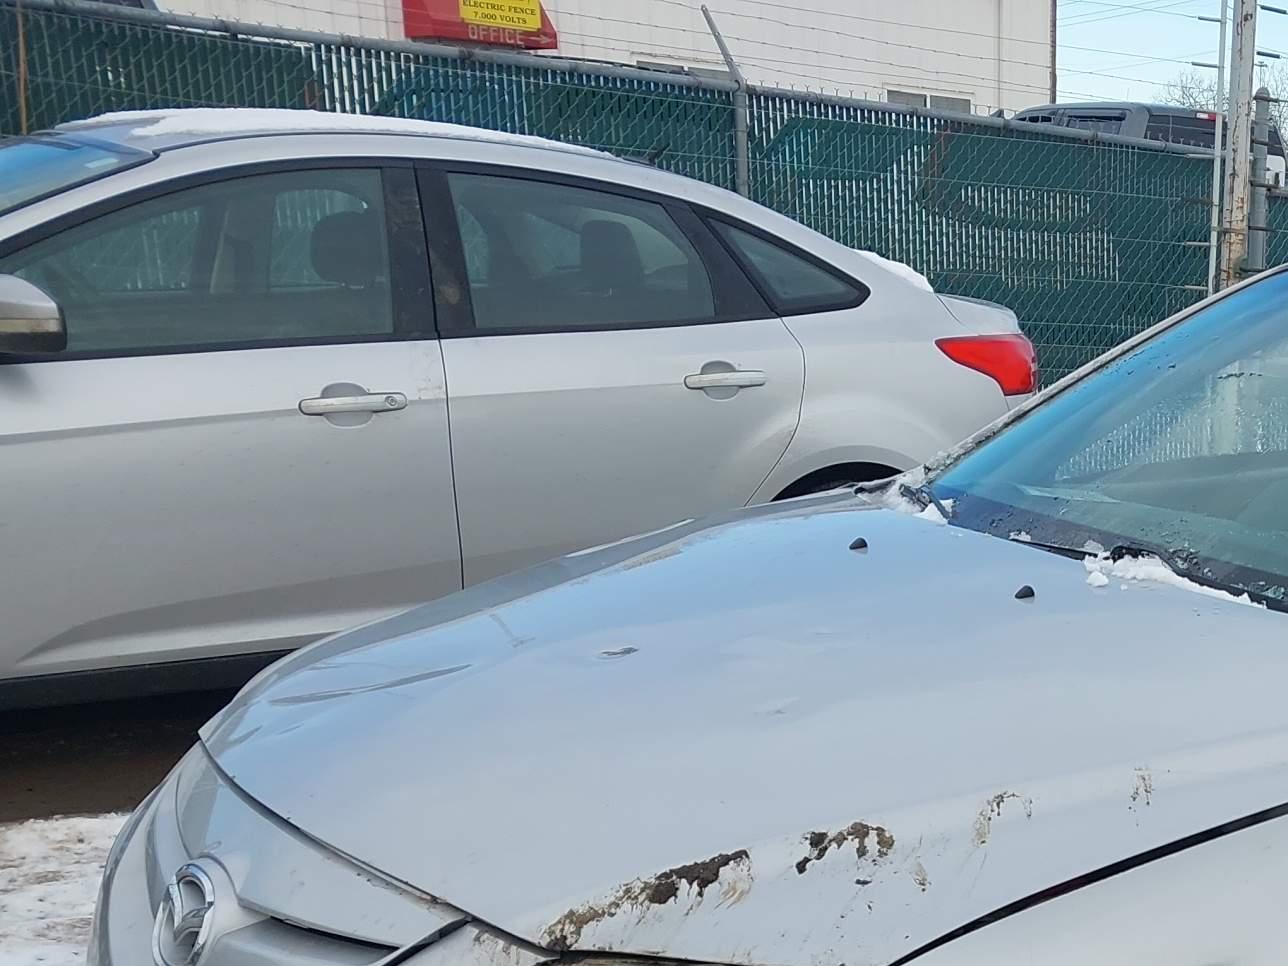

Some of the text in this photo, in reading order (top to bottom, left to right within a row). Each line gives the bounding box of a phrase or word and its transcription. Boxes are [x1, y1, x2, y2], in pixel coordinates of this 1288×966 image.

[462, 0, 536, 15] ELECTRIC FENCE
[499, 15, 527, 24] VOLTS
[468, 24, 525, 45] OFFICE
